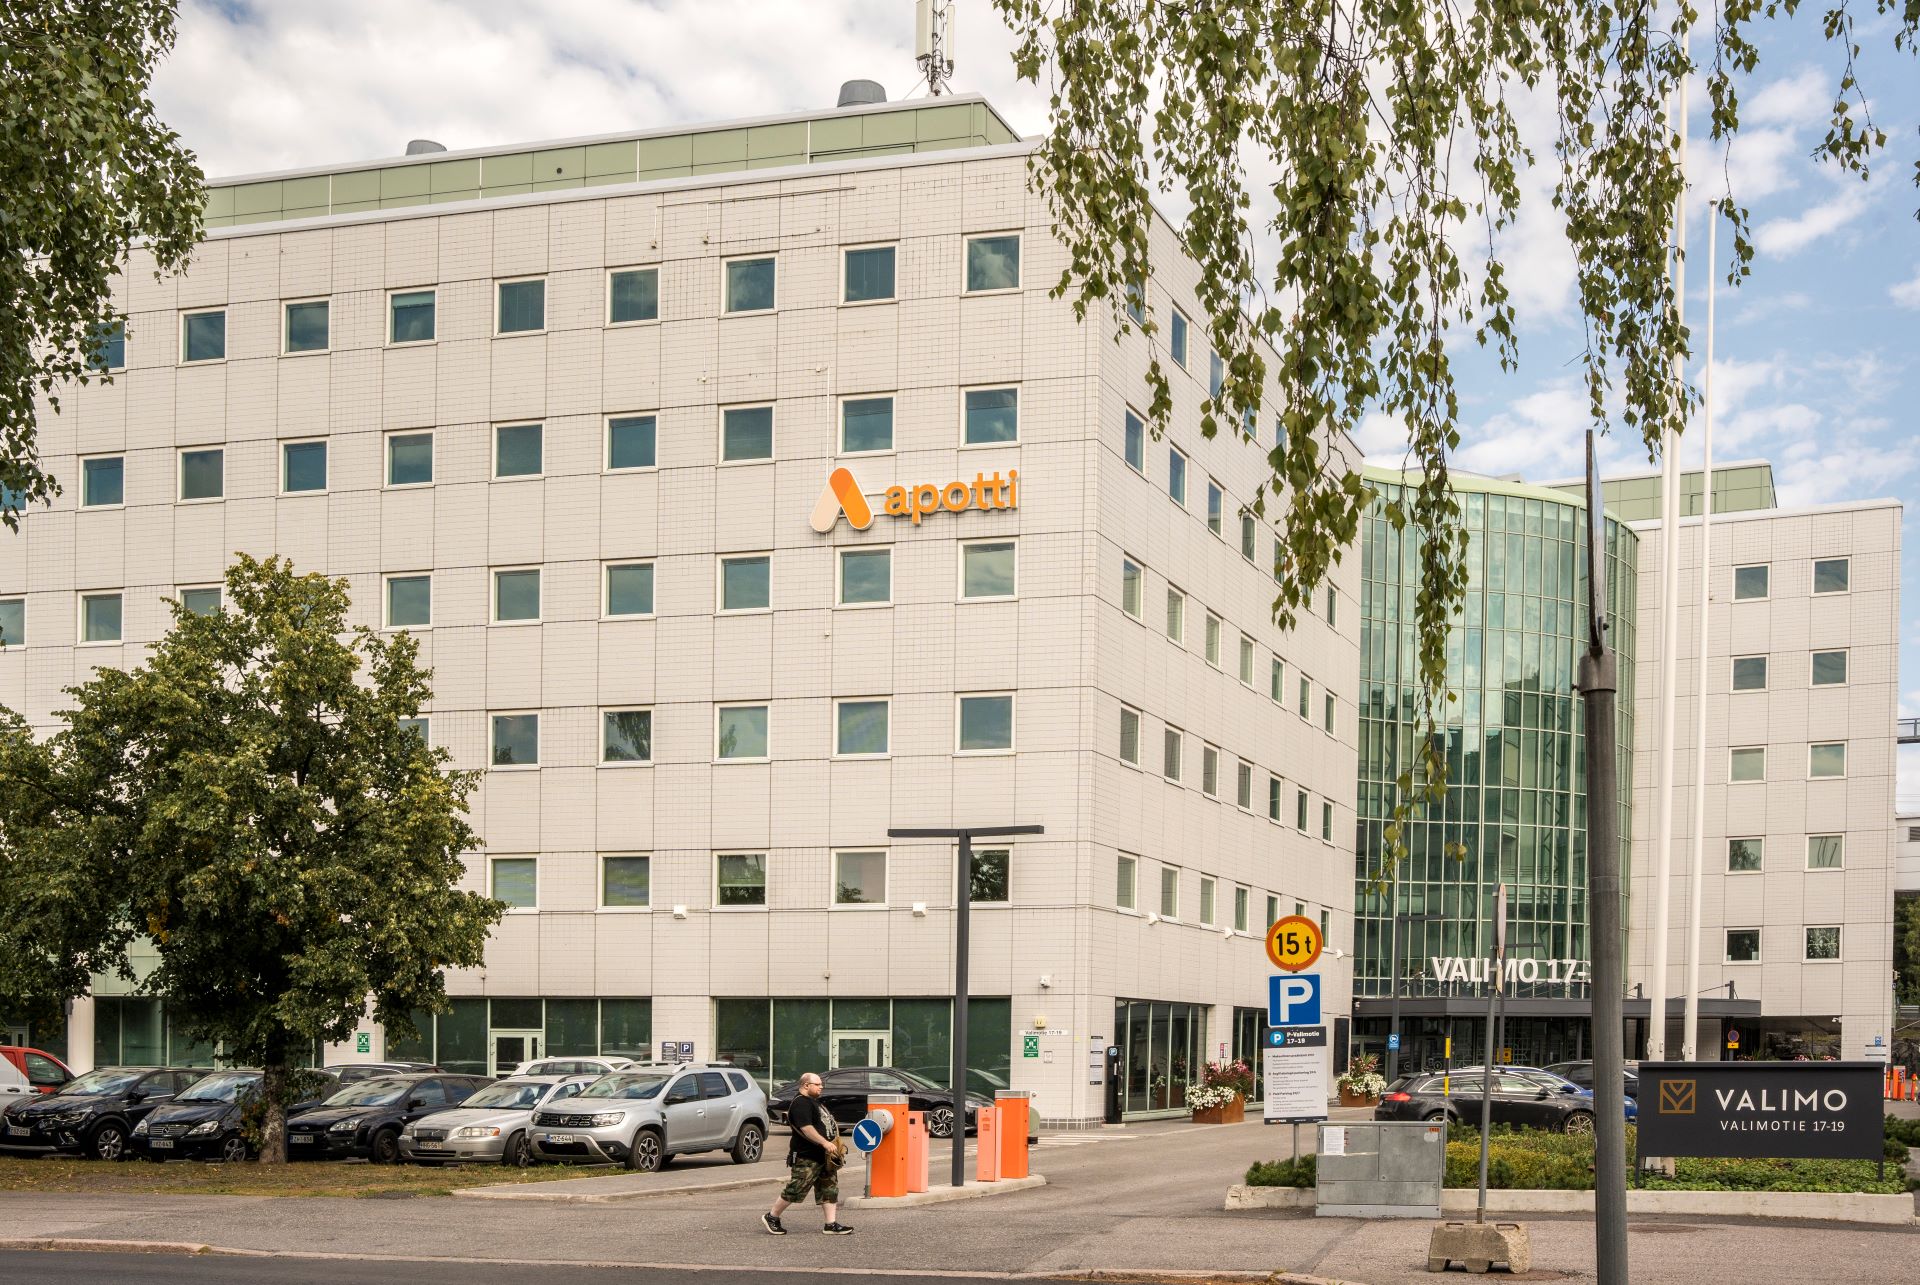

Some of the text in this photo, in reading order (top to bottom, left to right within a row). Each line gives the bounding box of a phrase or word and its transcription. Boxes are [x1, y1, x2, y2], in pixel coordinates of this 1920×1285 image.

[884, 469, 1018, 525] apotti
[1276, 932, 1312, 956] 15 t
[1547, 958, 1592, 984] 17-
[1279, 978, 1314, 1023] P
[1715, 1088, 1848, 1112] VALIMO
[1720, 1120, 1845, 1132] VALIMOTIE 17-19
